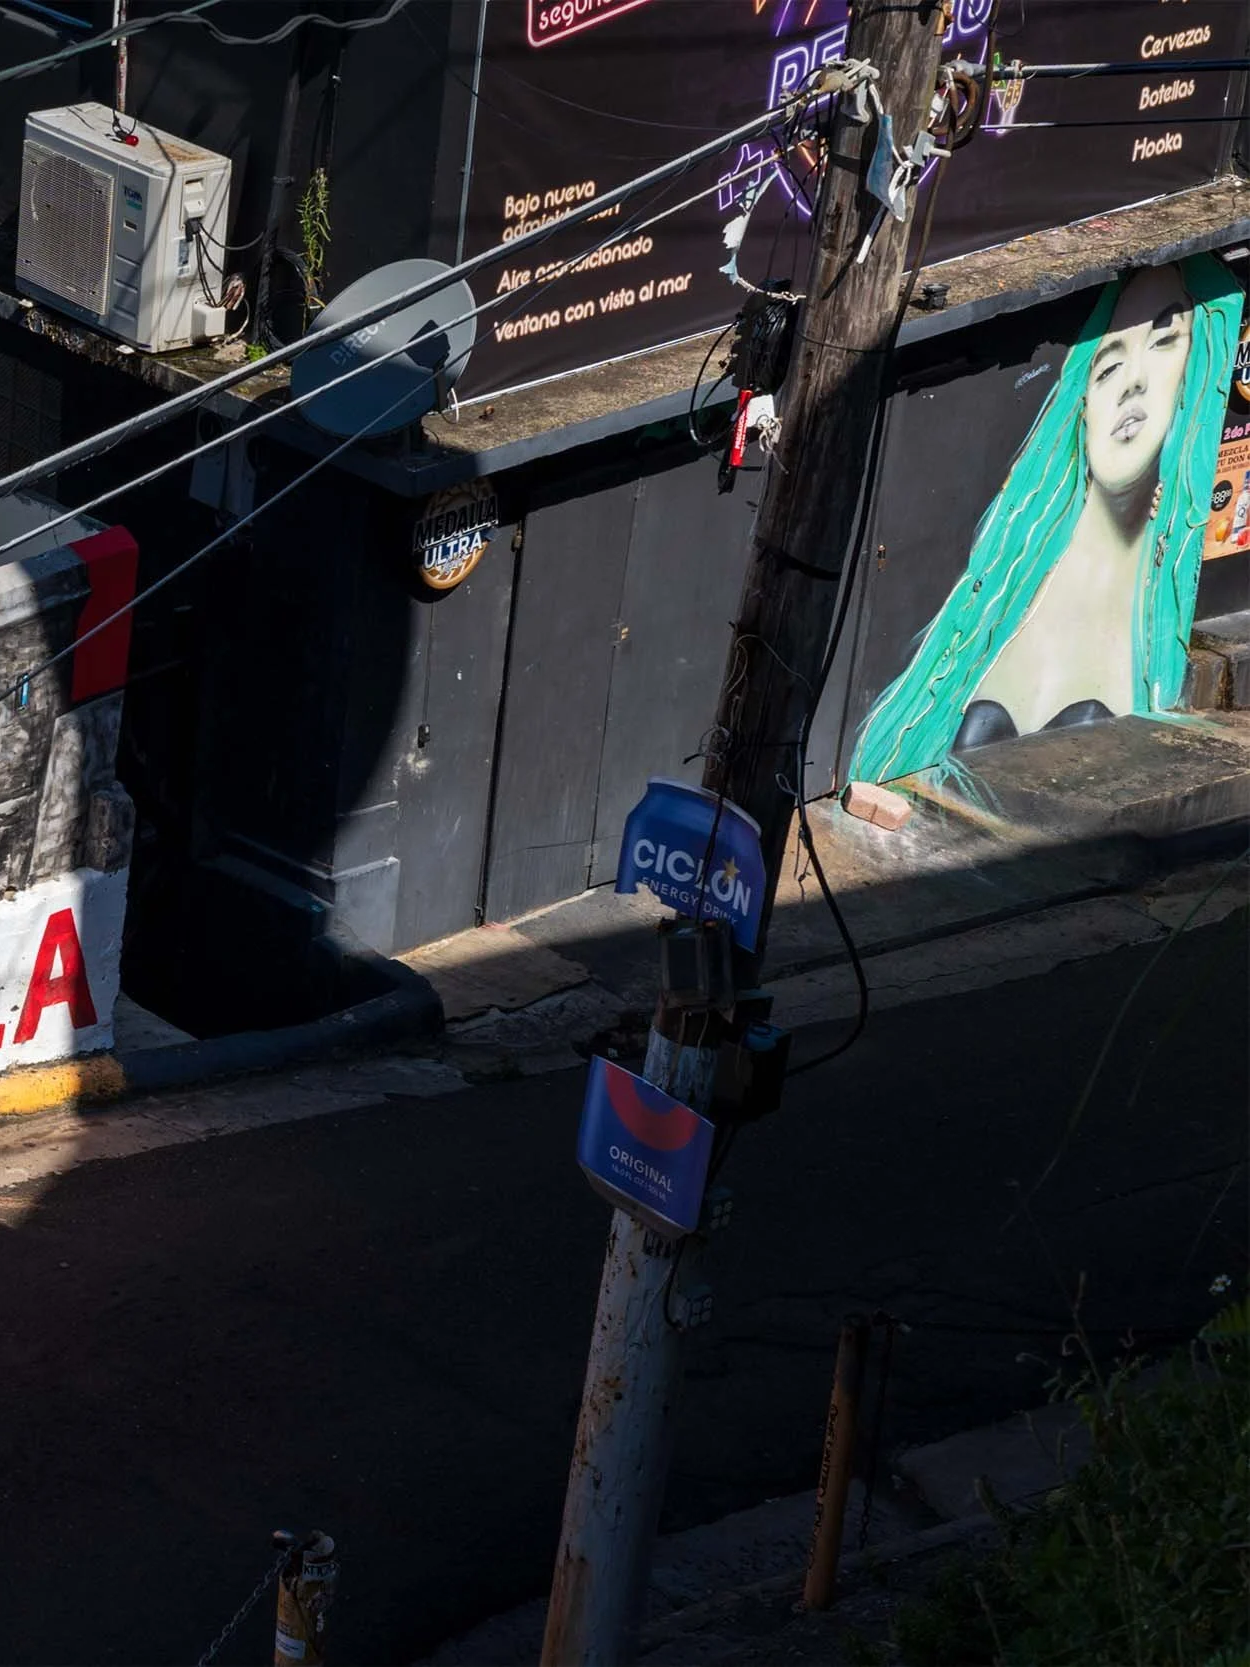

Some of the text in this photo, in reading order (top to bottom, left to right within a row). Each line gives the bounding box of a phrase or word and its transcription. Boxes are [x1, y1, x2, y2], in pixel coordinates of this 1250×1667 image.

[1141, 25, 1211, 59] Cervezas
[1138, 79, 1195, 110] Botellas
[1132, 132, 1183, 162] Hooka
[504, 180, 596, 219] Bajo nueva
[497, 268, 531, 293] Aire
[565, 300, 595, 322] con
[600, 288, 635, 312] vista
[639, 280, 654, 301] al
[657, 272, 692, 297] mar
[424, 531, 483, 569] ULTRA
[641, 875, 701, 907] ENERGY
[609, 1145, 673, 1193] ORIGINAL
